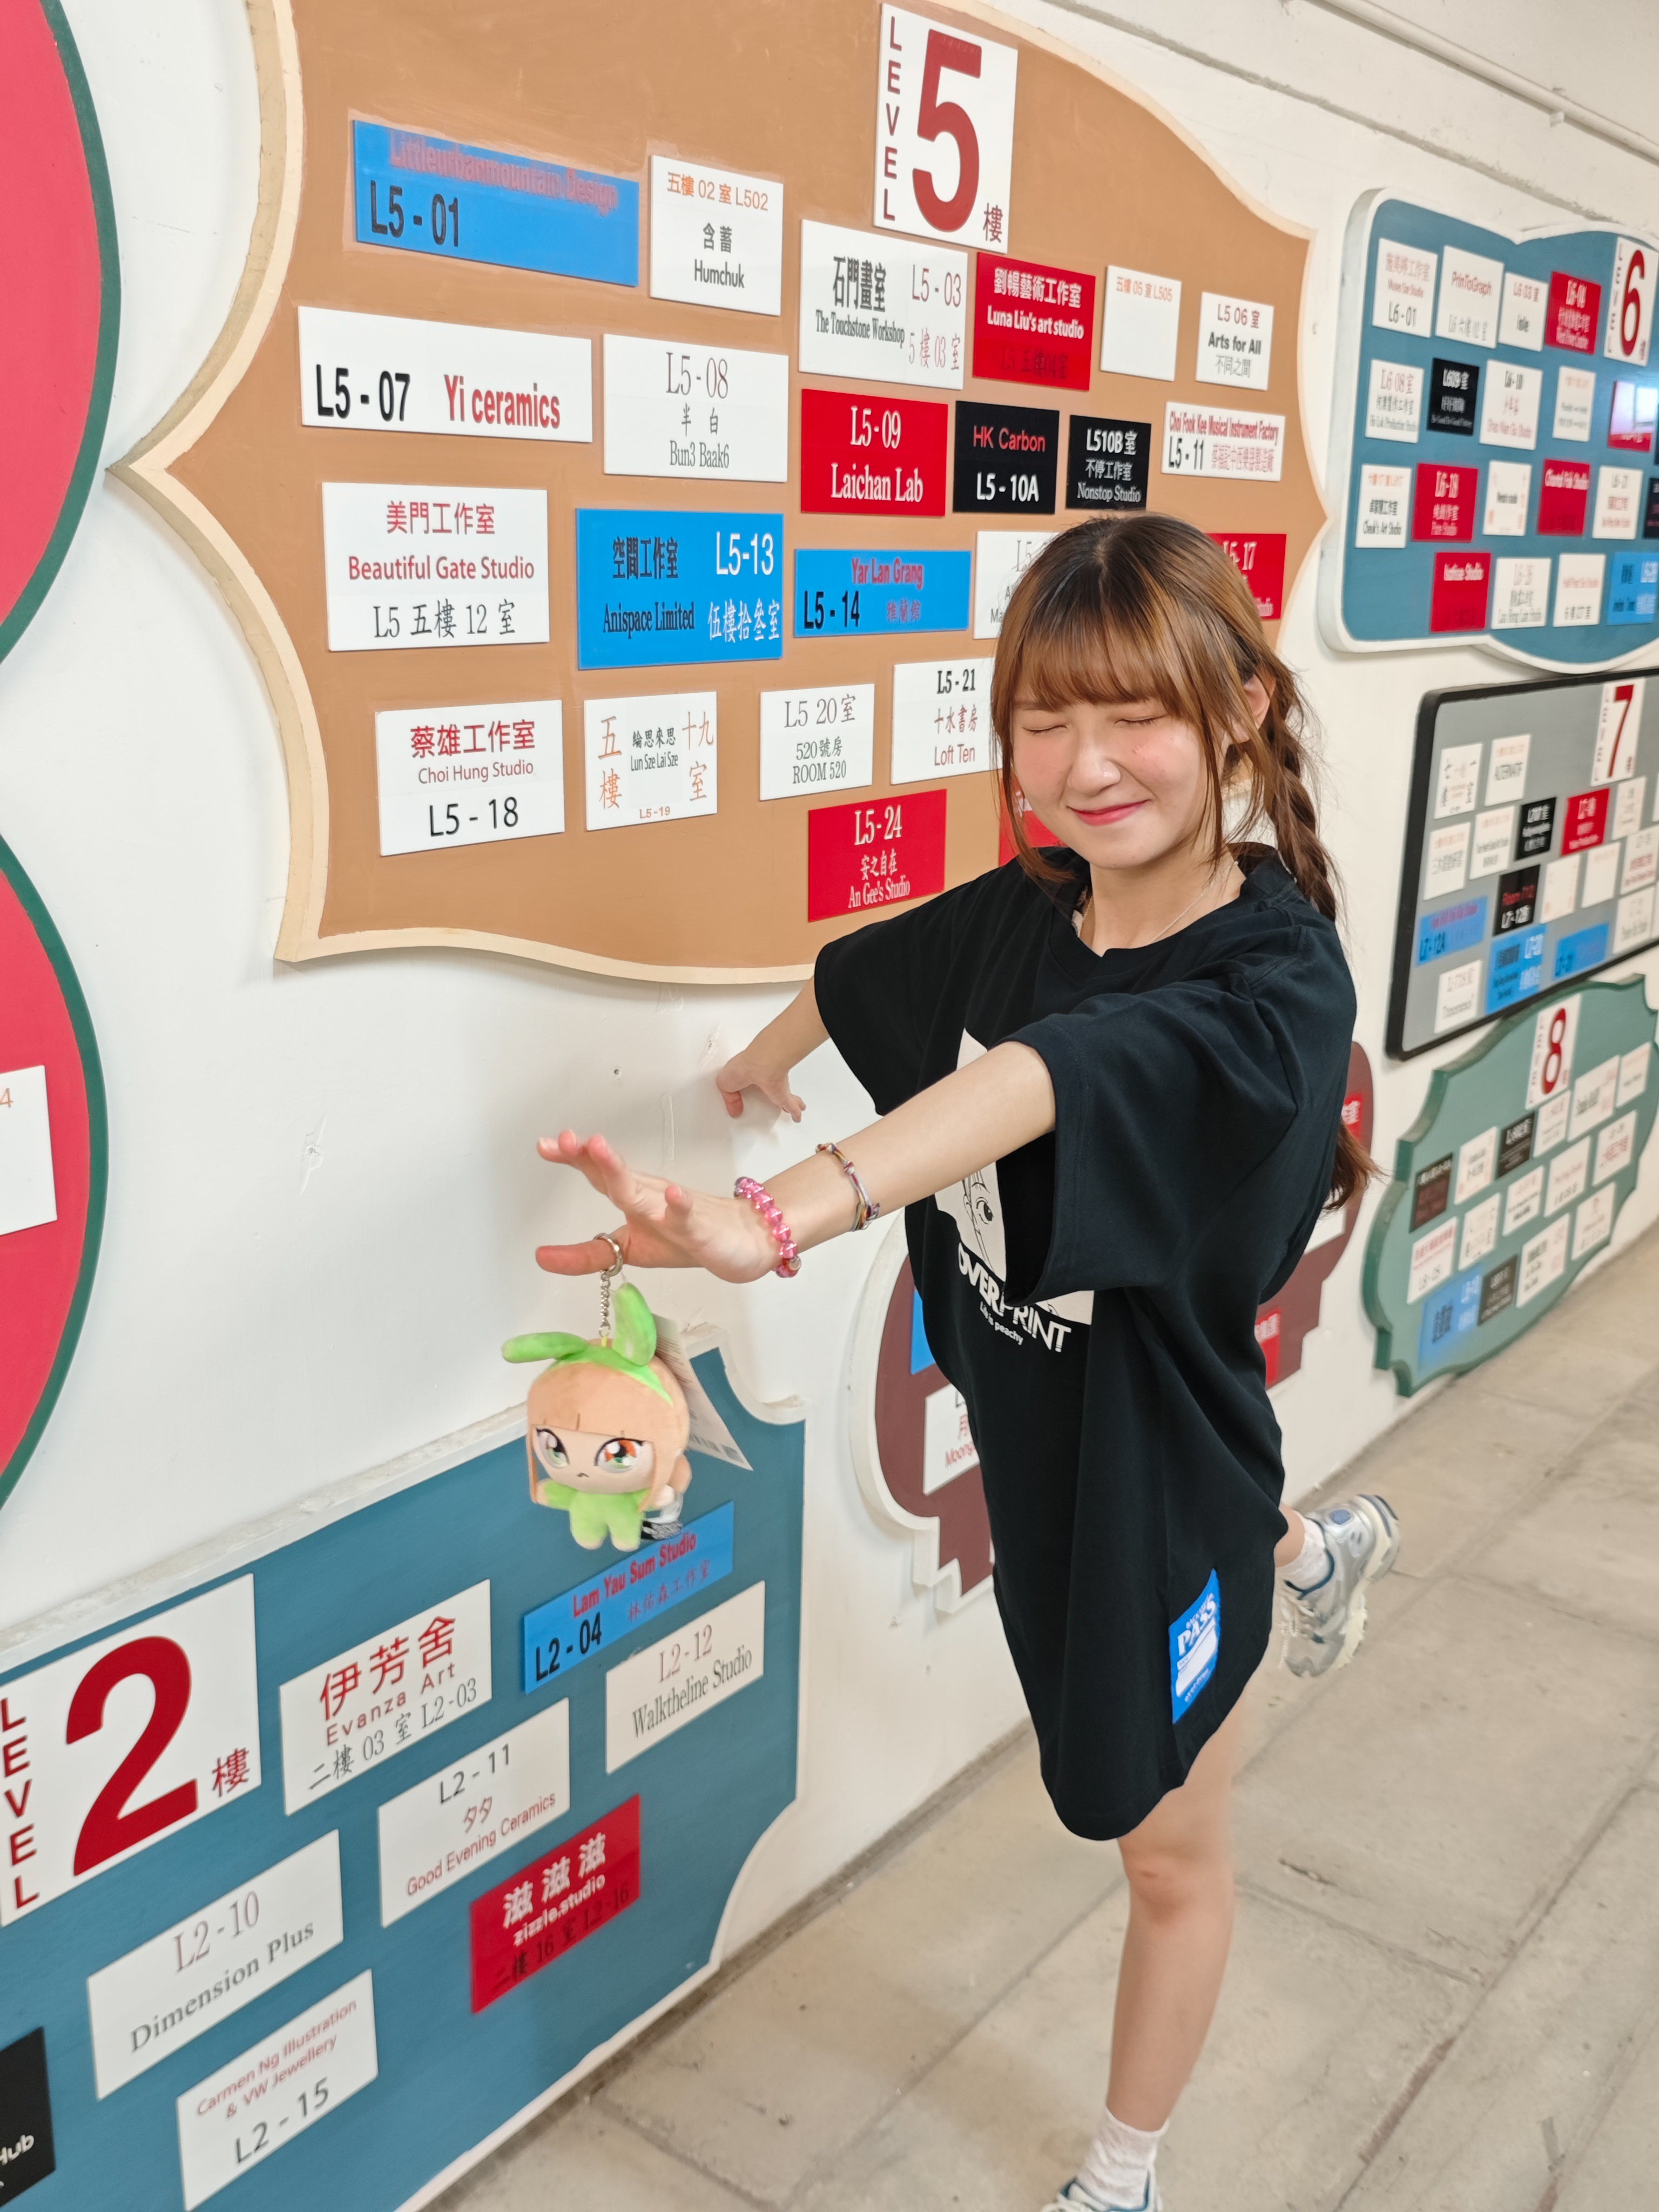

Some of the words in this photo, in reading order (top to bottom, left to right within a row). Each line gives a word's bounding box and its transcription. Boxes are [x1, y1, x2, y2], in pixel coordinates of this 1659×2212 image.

[884, 16, 902, 221] LEVEL
[913, 29, 982, 233] 5
[668, 171, 694, 198] 五樓
[699, 179, 715, 199] 02
[719, 184, 732, 204] 室
[736, 190, 768, 211] L502
[983, 203, 1003, 244] 樓
[694, 259, 744, 289] Humchuk
[833, 256, 887, 312] 石門畫室
[987, 305, 1012, 328] Luna
[1014, 309, 1035, 332] Liu's
[1037, 316, 1052, 334] art
[1054, 318, 1084, 340] studio
[1217, 304, 1230, 323] L5
[1234, 307, 1248, 326] 06
[1251, 310, 1260, 329] 室
[1621, 249, 1645, 356] 6
[816, 309, 828, 333] The
[831, 312, 871, 340] Touchstone
[872, 316, 905, 348] Workshop
[1208, 332, 1229, 350] Arts
[1232, 335, 1245, 352] for
[1249, 339, 1262, 355] All
[444, 374, 464, 421] Yi
[472, 382, 561, 429] ceramics
[670, 441, 696, 467] Bun3
[699, 442, 729, 469] Baak6
[974, 426, 994, 450] HK
[999, 428, 1046, 453] Carbon
[1087, 428, 1122, 454] L510B
[831, 463, 892, 503] Laichan
[895, 468, 924, 503] Lab
[1085, 459, 1132, 483] 不停工作室
[1077, 482, 1112, 503] Nonstop
[1114, 483, 1141, 503] Studio
[387, 501, 496, 535] 美門工作室
[349, 555, 430, 581] Beautiful
[436, 556, 476, 581] Gate
[481, 556, 534, 579] Studio
[612, 537, 678, 581] 空間工作室
[716, 532, 774, 576] L5-13
[851, 558, 868, 584] Yar
[871, 559, 891, 584] Lan
[893, 558, 924, 590] Grang
[374, 605, 399, 639] L5
[410, 598, 455, 639] 五樓
[467, 603, 487, 635] 12
[498, 598, 516, 636] 室
[603, 603, 652, 640] Anispace
[655, 601, 695, 631] Limited
[784, 700, 808, 730] L5
[1607, 684, 1634, 778] 7
[410, 719, 536, 759] 蔡雄工作室
[935, 744, 955, 767] Loft
[956, 744, 975, 764] Ten
[418, 765, 449, 786] Choi
[453, 762, 489, 787] Hung
[493, 759, 534, 778] Studio
[631, 753, 643, 771] Lun
[644, 753, 656, 771] Sze
[657, 752, 666, 768] Lai
[667, 751, 678, 767] Sze
[793, 764, 827, 785] ROOM
[830, 760, 847, 780] 520
[639, 805, 671, 820] L5-19
[848, 887, 861, 909] An
[863, 880, 884, 906] Gee's
[886, 875, 911, 900] Studio
[1541, 1008, 1566, 1095] 8
[994, 1321, 1024, 1346] peachy
[573, 1586, 600, 1618] Lam
[603, 1572, 626, 1600] Yau
[630, 1552, 656, 1584] Sum
[659, 1531, 697, 1568] Studio
[1177, 1599, 1217, 1657] PASS
[320, 1615, 456, 1721] 伊芳舍
[326, 1694, 407, 1747] Evanza
[420, 1662, 456, 1697] Art
[631, 1673, 709, 1739] Walktheline
[712, 1644, 753, 1690] Studio
[66, 1635, 198, 1877] 2
[362, 1730, 385, 1762] 03
[394, 1713, 413, 1746] 室
[212, 1746, 251, 1798] 樓
[1, 1697, 39, 1909] LEVEL
[406, 1866, 443, 1898] Good
[447, 1829, 497, 1872] Evening
[500, 1792, 556, 1836] Ceramics
[130, 1956, 260, 2054] Dimension
[267, 1921, 315, 1965] Plus
[196, 2068, 256, 2117] Carmen
[259, 2051, 280, 2077] Ng
[283, 1999, 358, 2059] Illustration
[226, 2103, 237, 2119] &
[243, 2077, 268, 2107] VW
[272, 2035, 339, 2090] Jewellery
